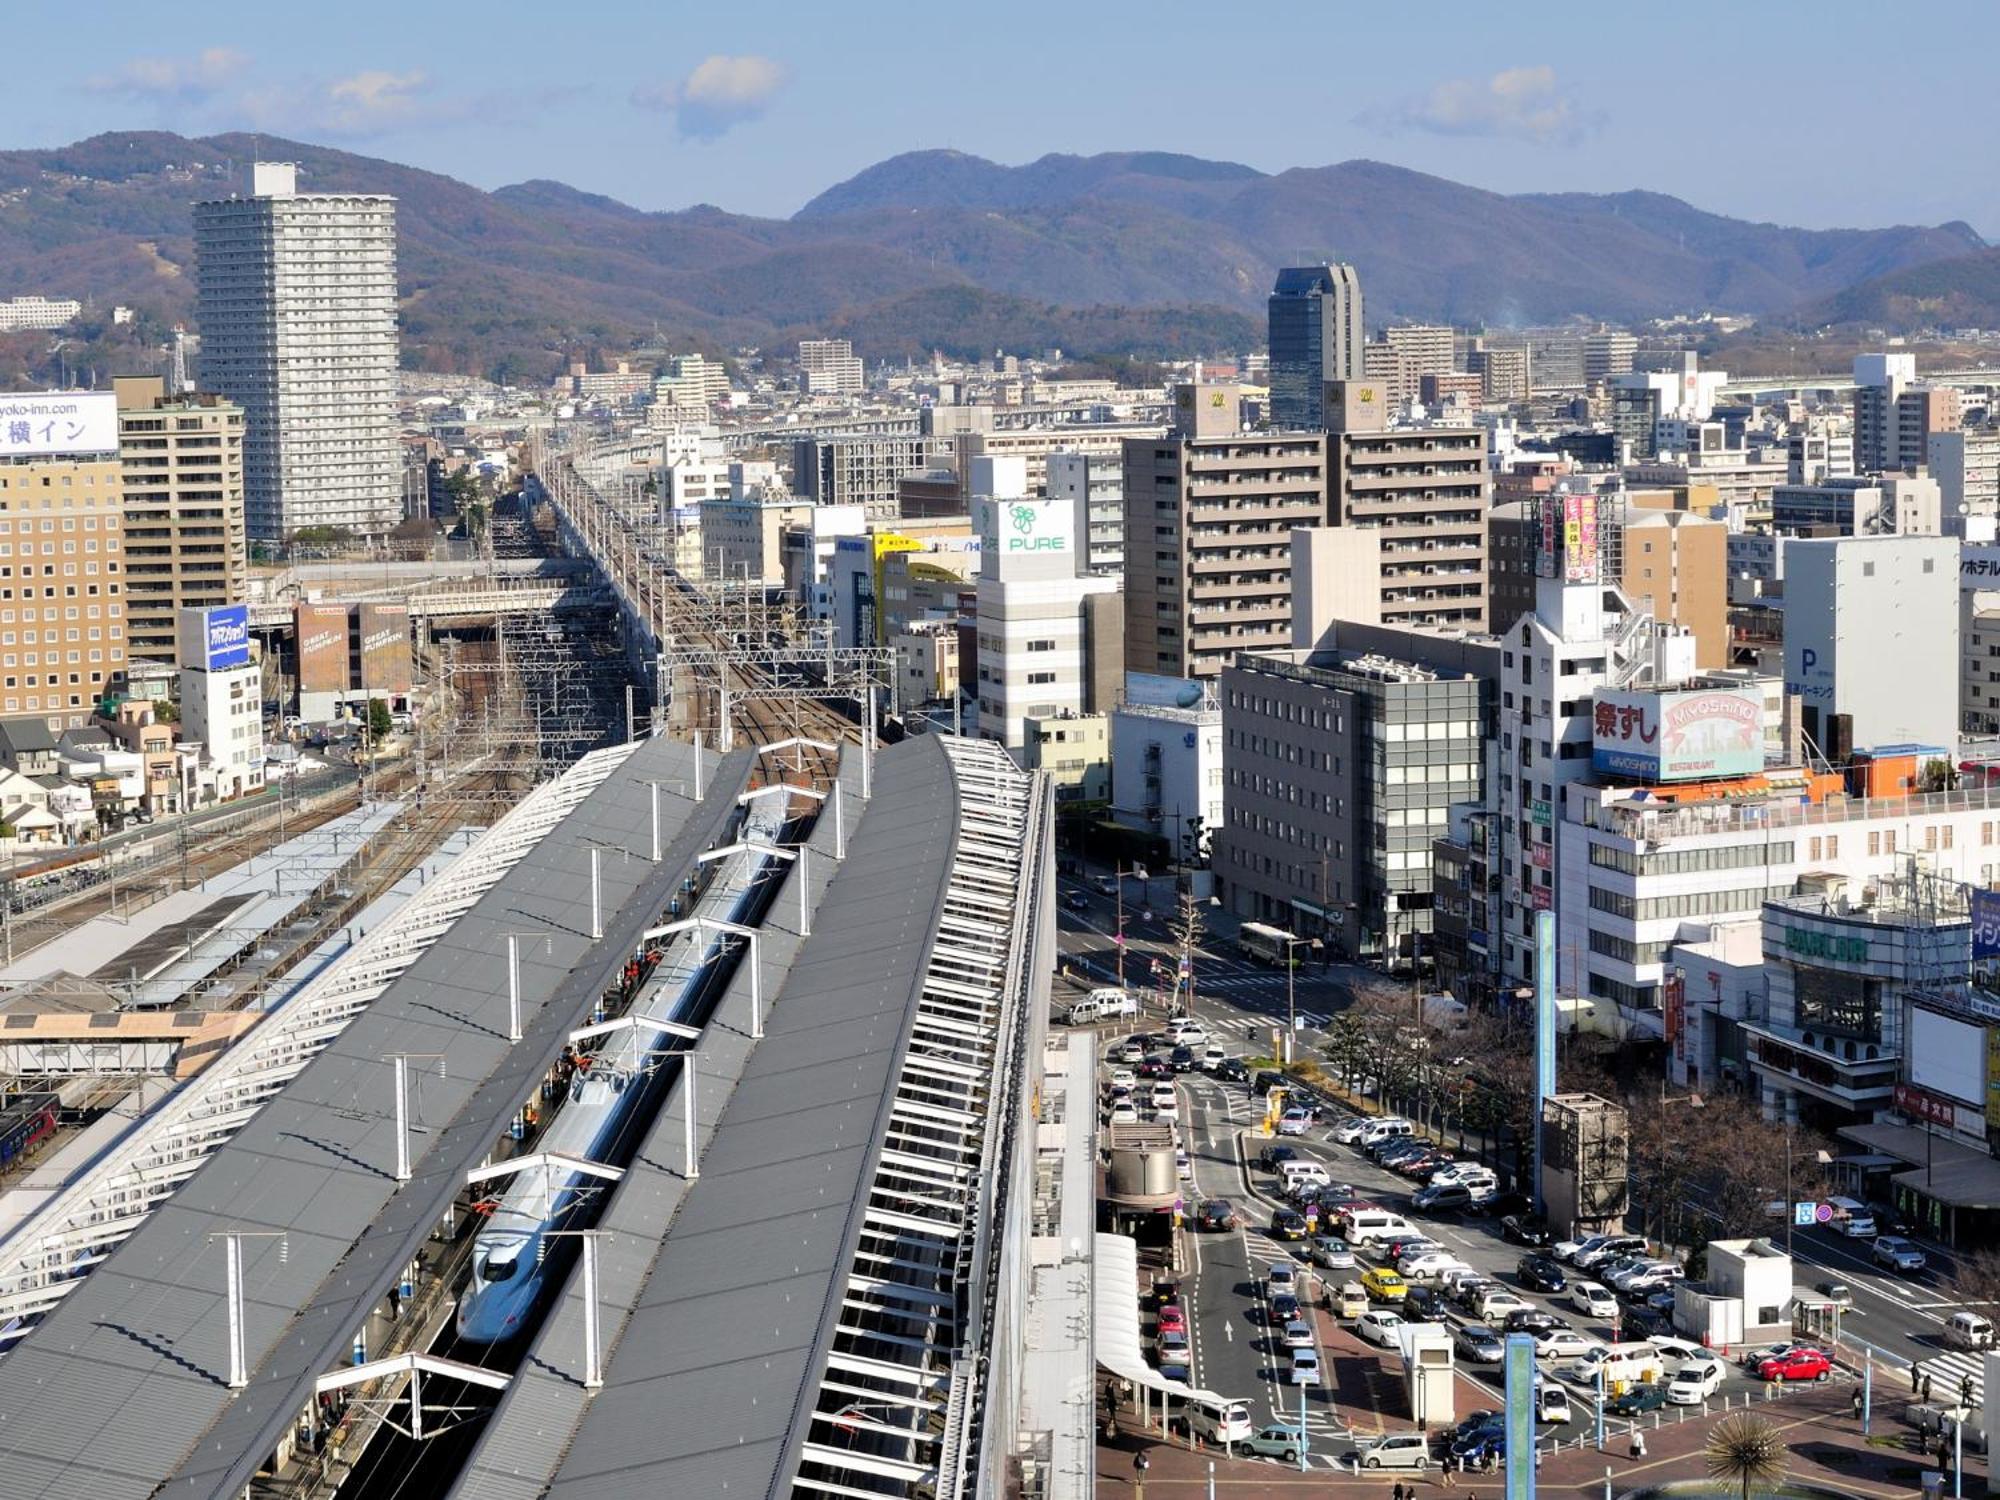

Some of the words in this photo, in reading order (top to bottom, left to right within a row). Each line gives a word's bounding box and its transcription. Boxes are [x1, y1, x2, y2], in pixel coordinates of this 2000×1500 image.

[0, 420, 86, 444] 横イン
[1009, 535, 1066, 552] PURE
[303, 630, 329, 647] GREAT
[364, 628, 390, 645] GREAT
[364, 631, 403, 653] PUMPKIN
[1802, 648, 1816, 676] P
[1595, 701, 1658, 744] 祭ずし
[1672, 701, 1754, 726] MIYOSHINO
[1608, 756, 1658, 772] MIYOSHINO
[1668, 760, 1716, 773] RESTAURANT
